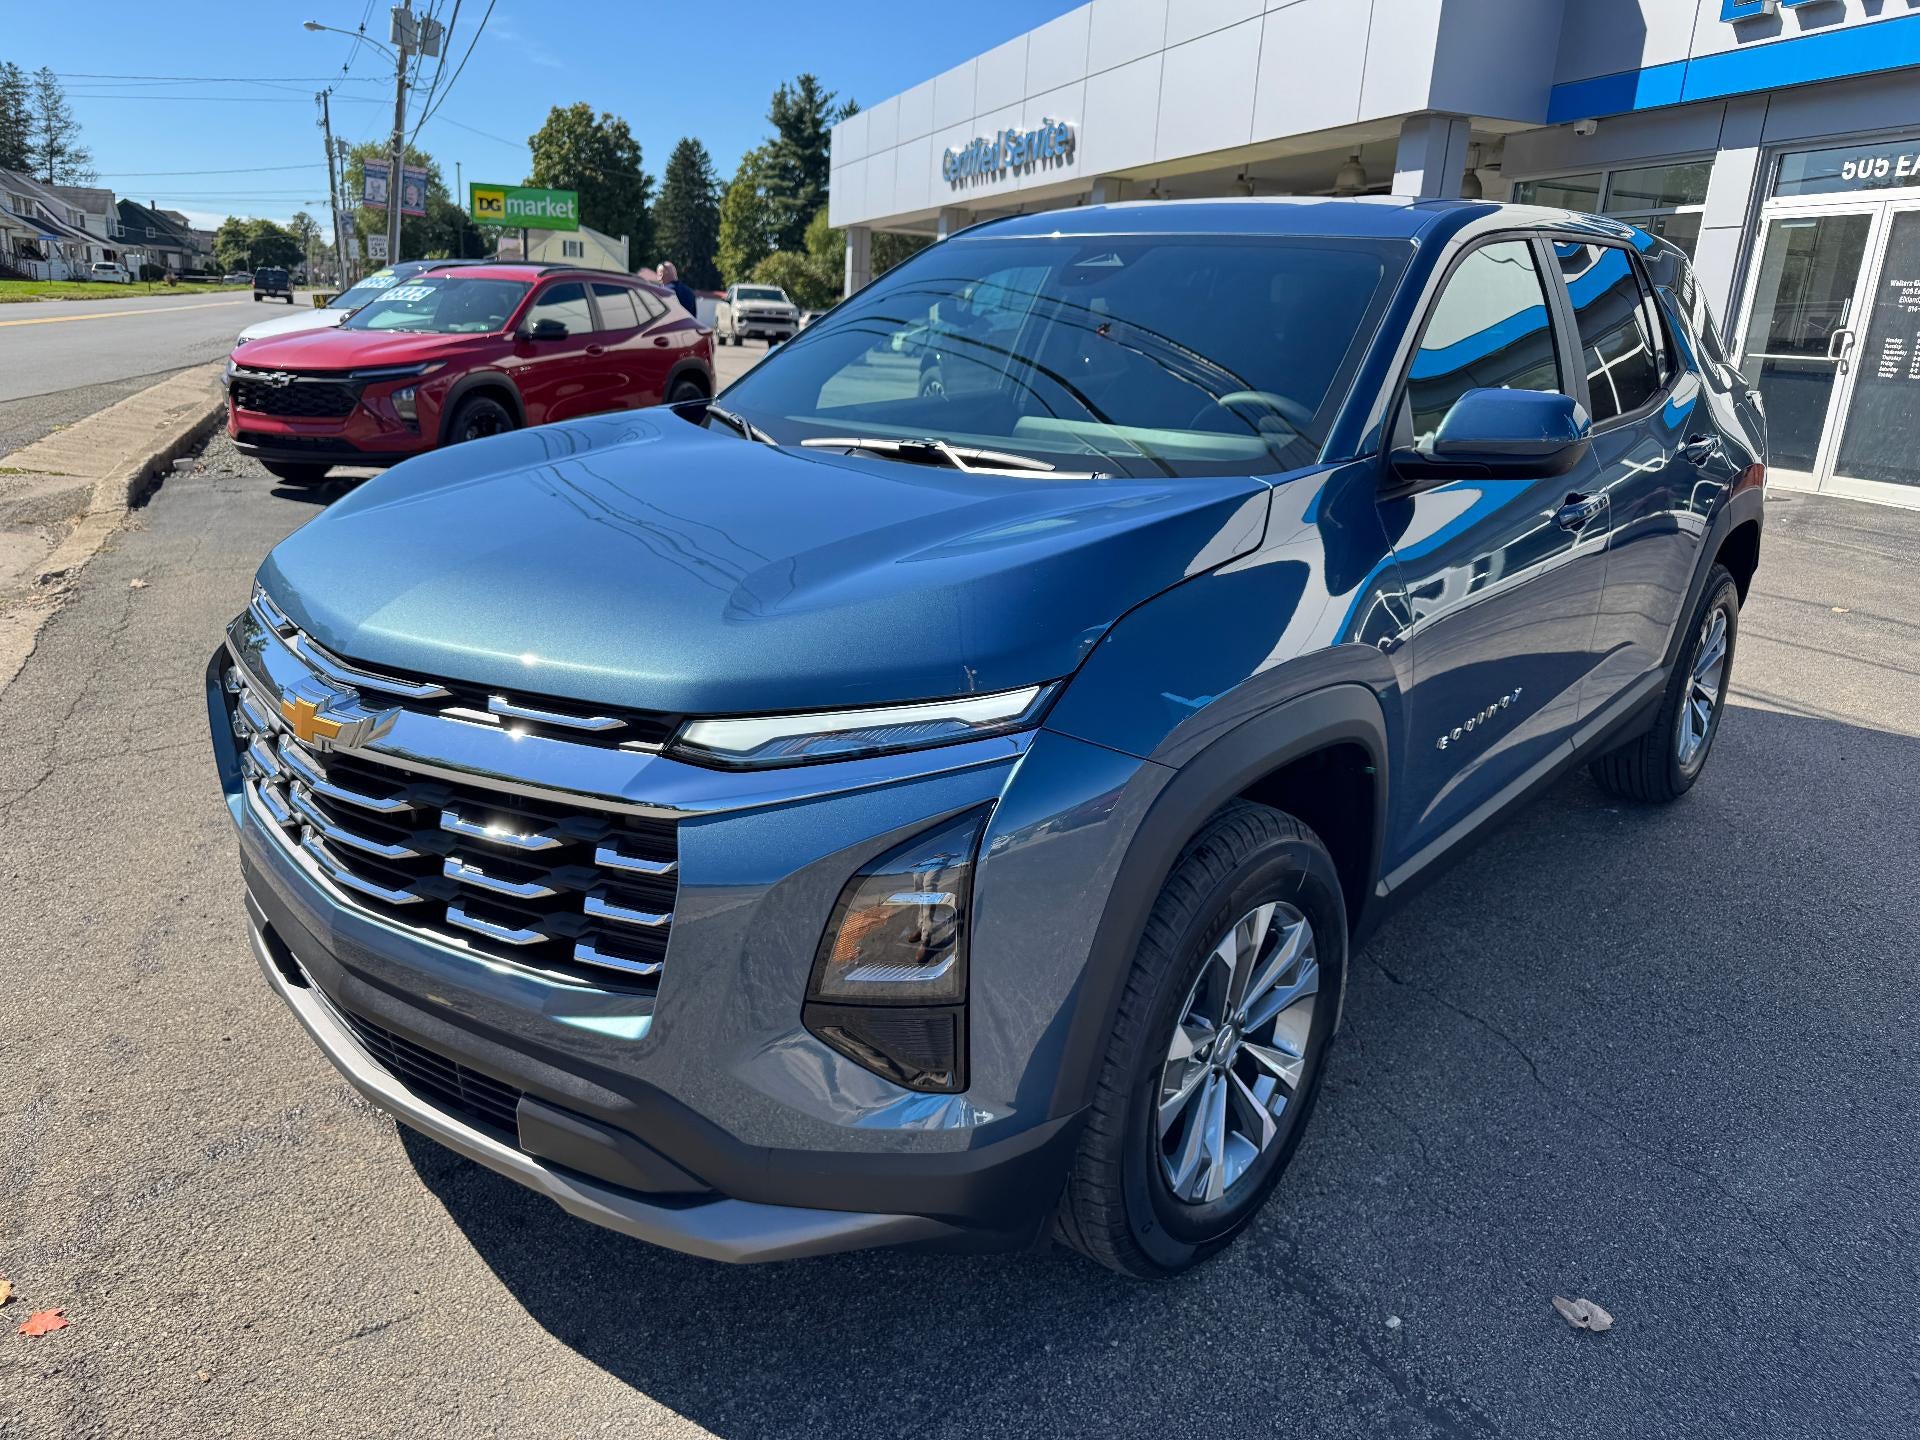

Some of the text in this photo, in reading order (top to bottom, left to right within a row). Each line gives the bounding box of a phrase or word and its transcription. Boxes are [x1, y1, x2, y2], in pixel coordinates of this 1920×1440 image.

[943, 117, 1070, 182] Certified Service
[477, 196, 575, 219] DG market
[371, 247, 387, 257] 35
